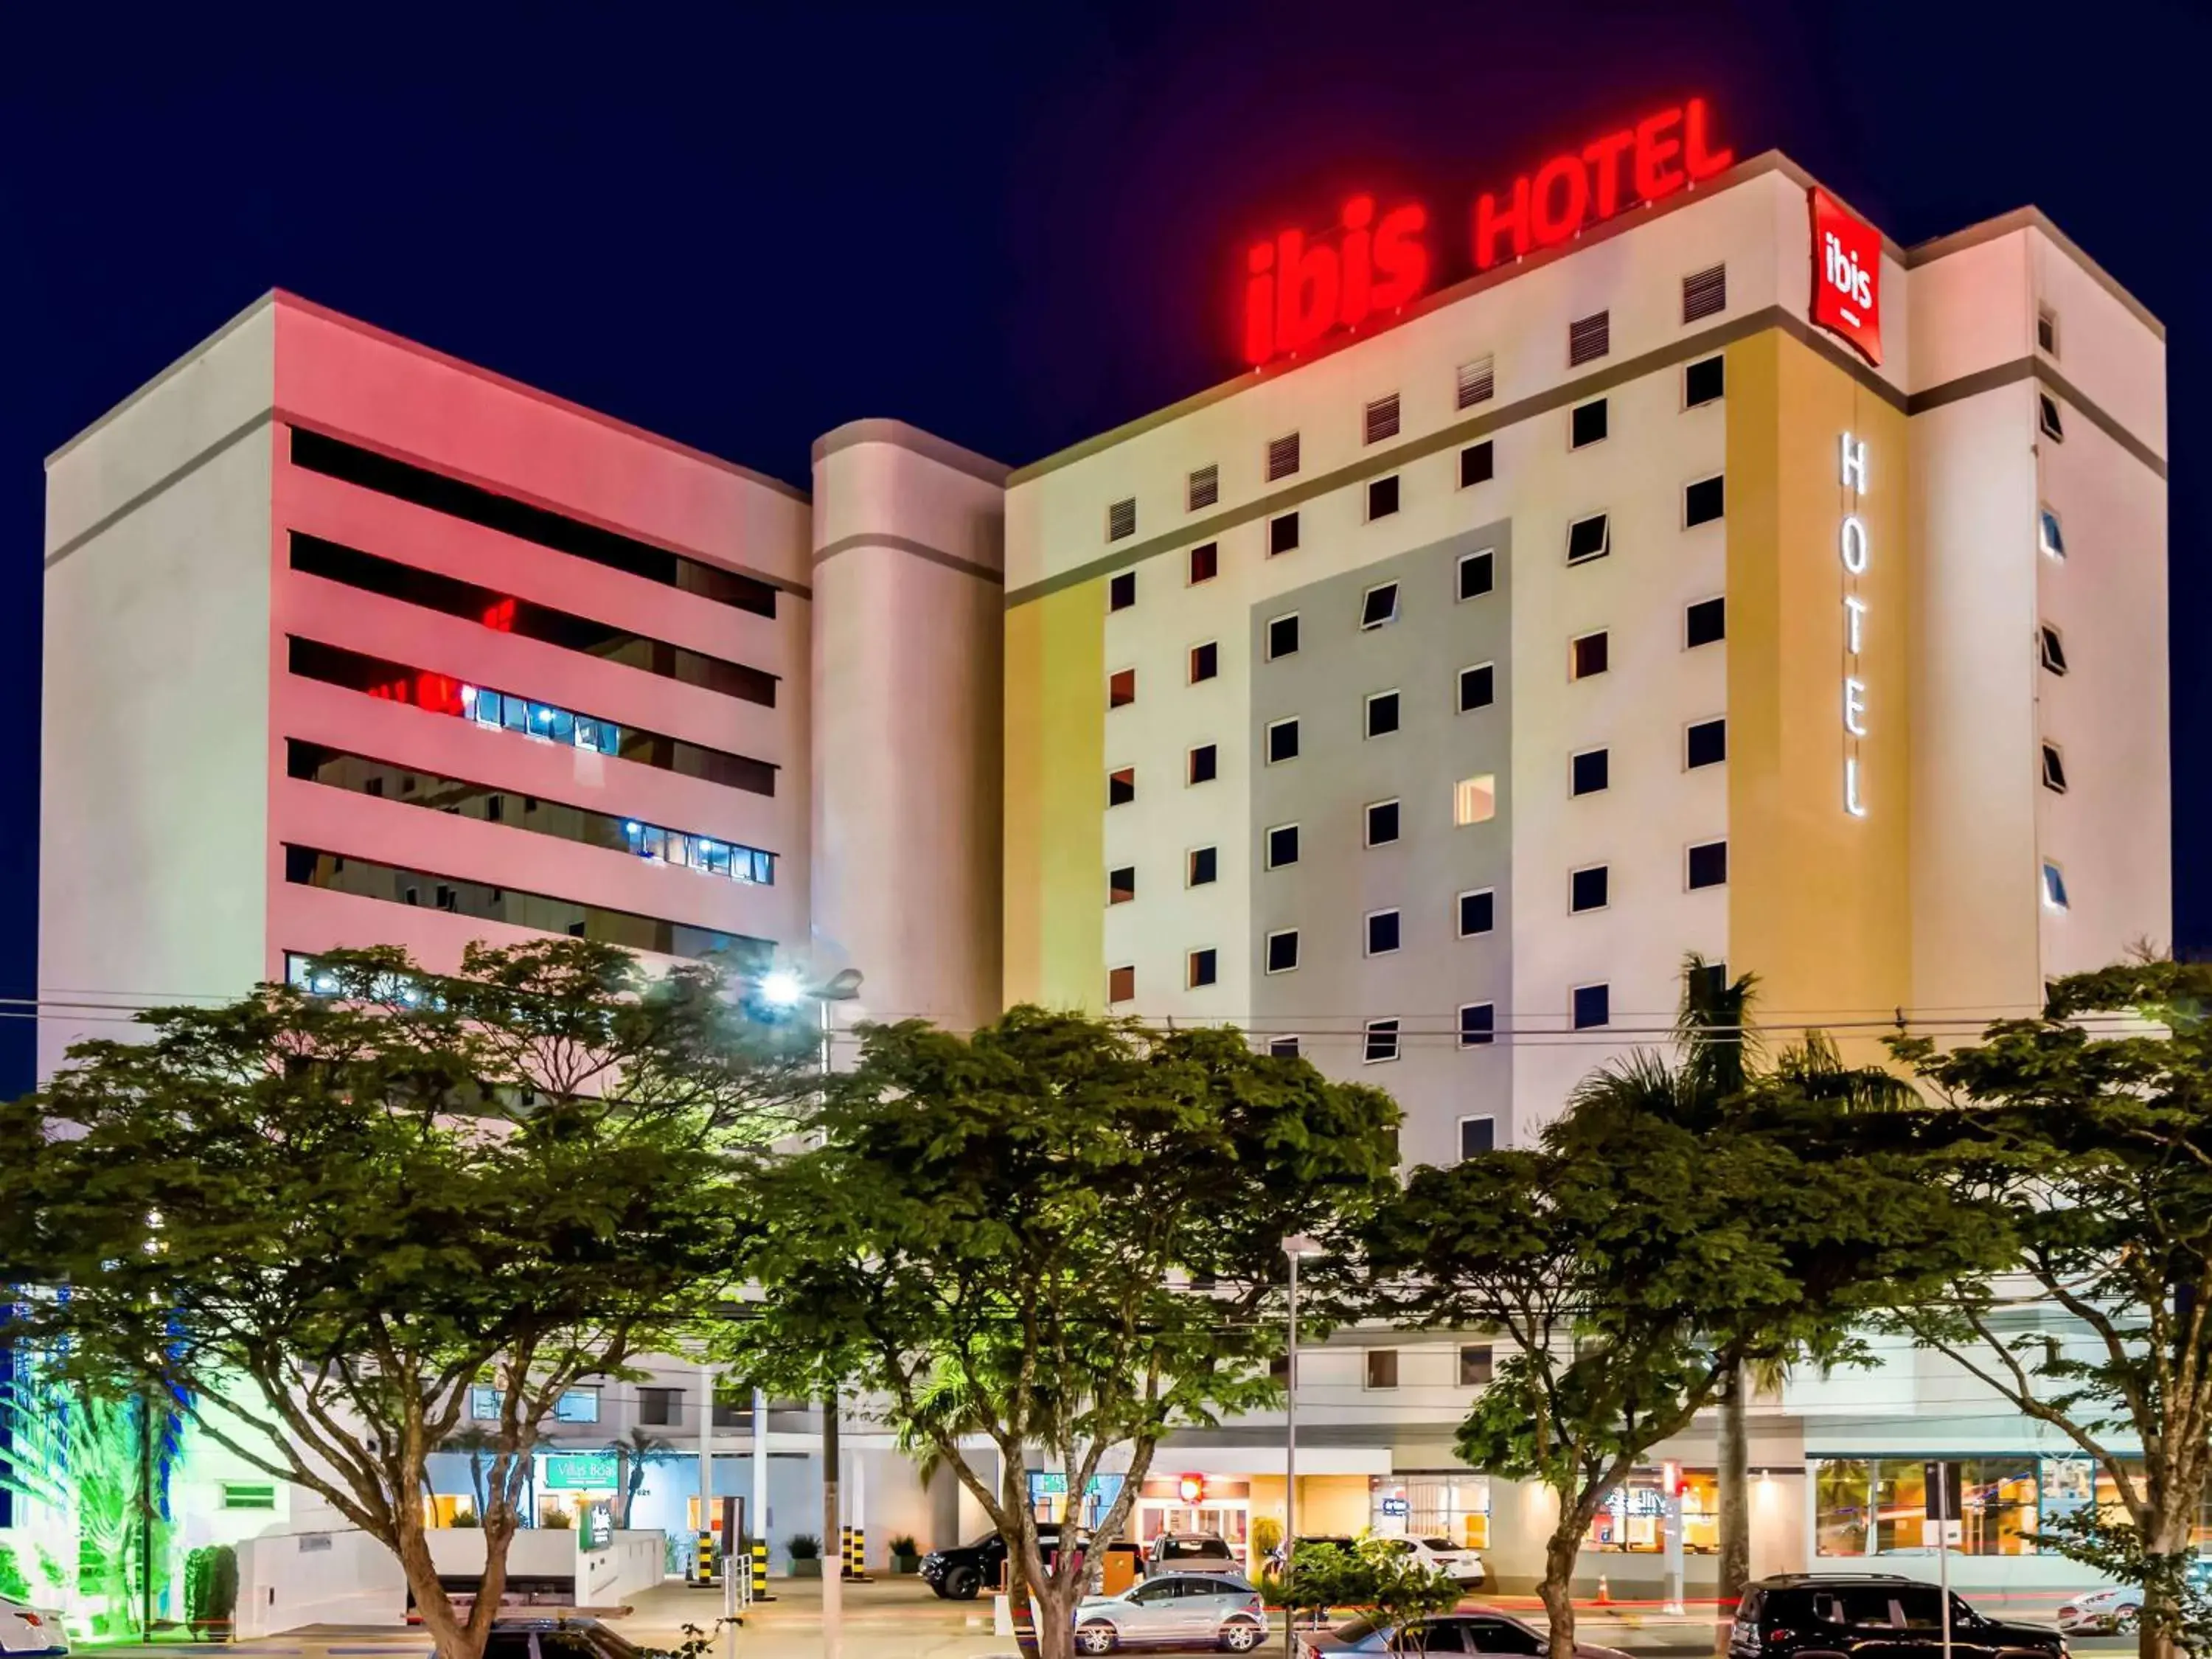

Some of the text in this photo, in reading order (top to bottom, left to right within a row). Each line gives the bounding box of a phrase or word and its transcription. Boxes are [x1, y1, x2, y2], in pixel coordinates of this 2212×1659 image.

[1245, 97, 1733, 366] ibis HOTEL
[1825, 231, 1873, 310] ibis
[1841, 430, 1867, 817] HOTEL
